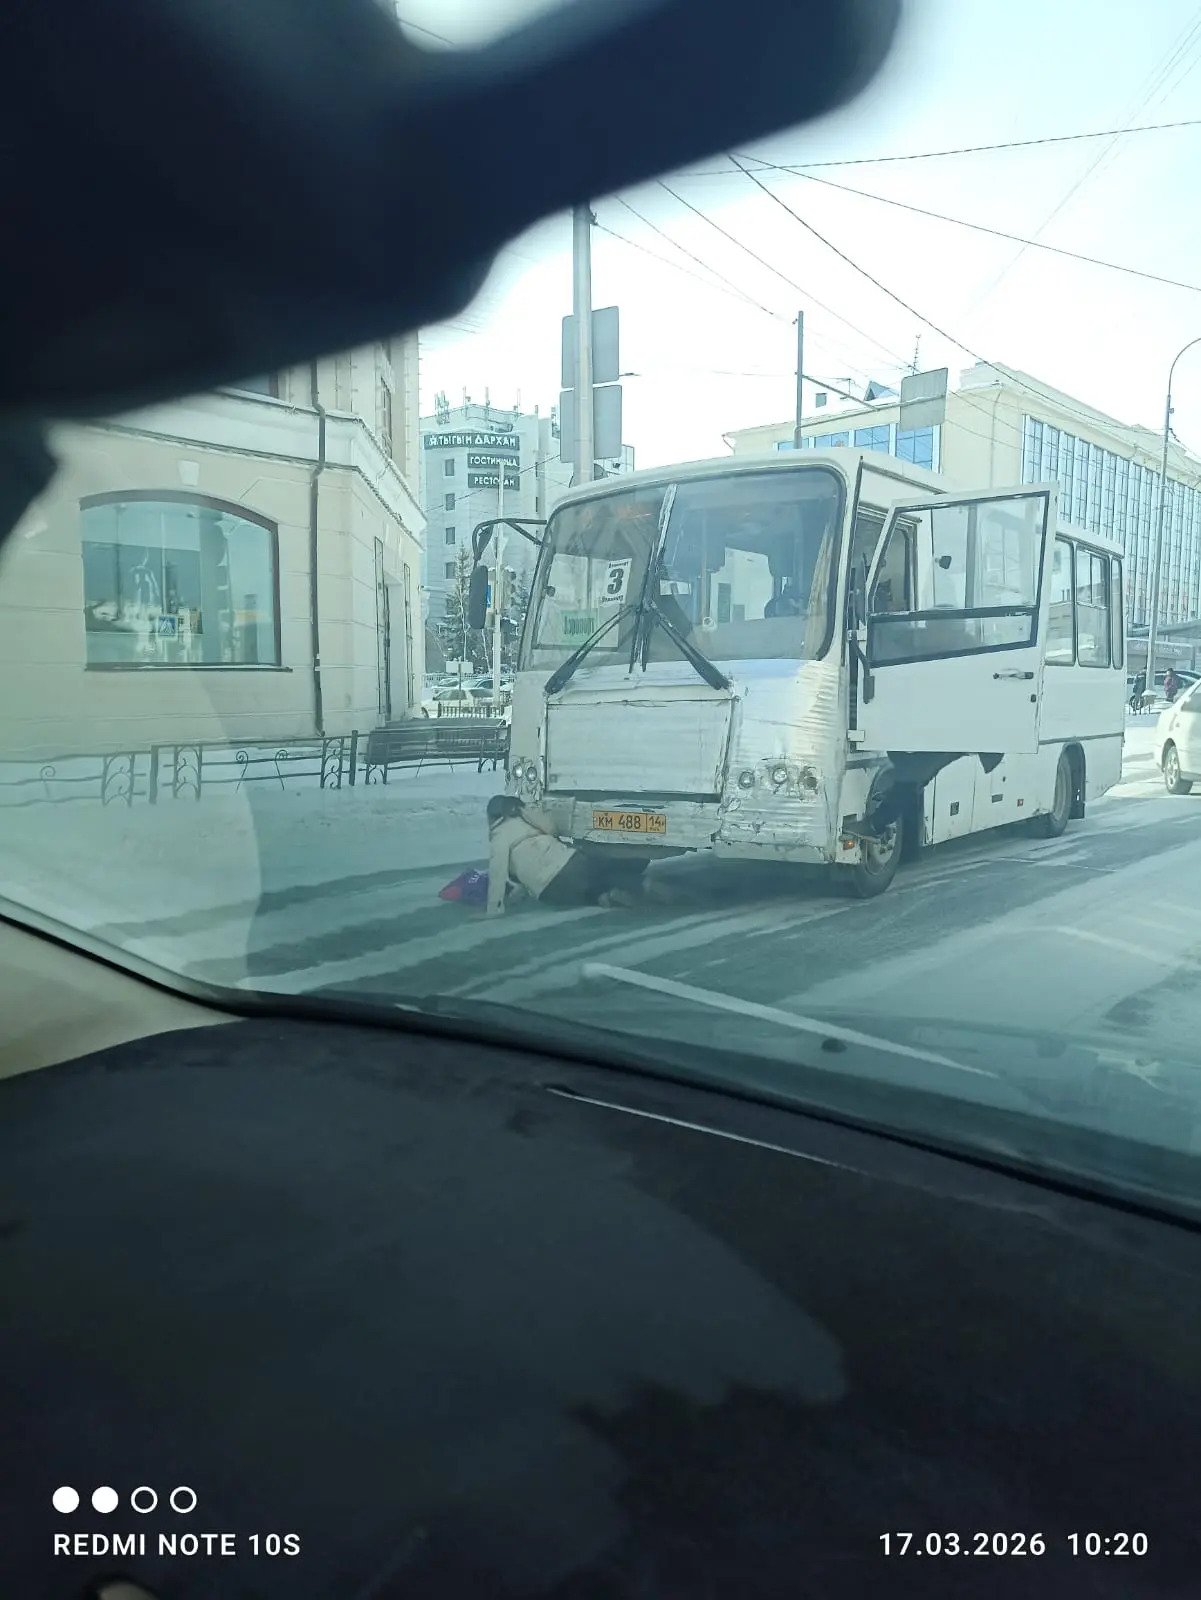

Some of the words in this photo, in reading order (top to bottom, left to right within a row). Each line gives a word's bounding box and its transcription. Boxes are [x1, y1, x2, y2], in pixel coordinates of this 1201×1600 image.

[440, 436, 472, 445] ТЫГЫН
[475, 435, 516, 446] ДАРХАН
[474, 477, 515, 486] РЕСТОАН
[607, 568, 624, 595] 3
[618, 814, 641, 829] 488
[649, 816, 661, 826] 14
